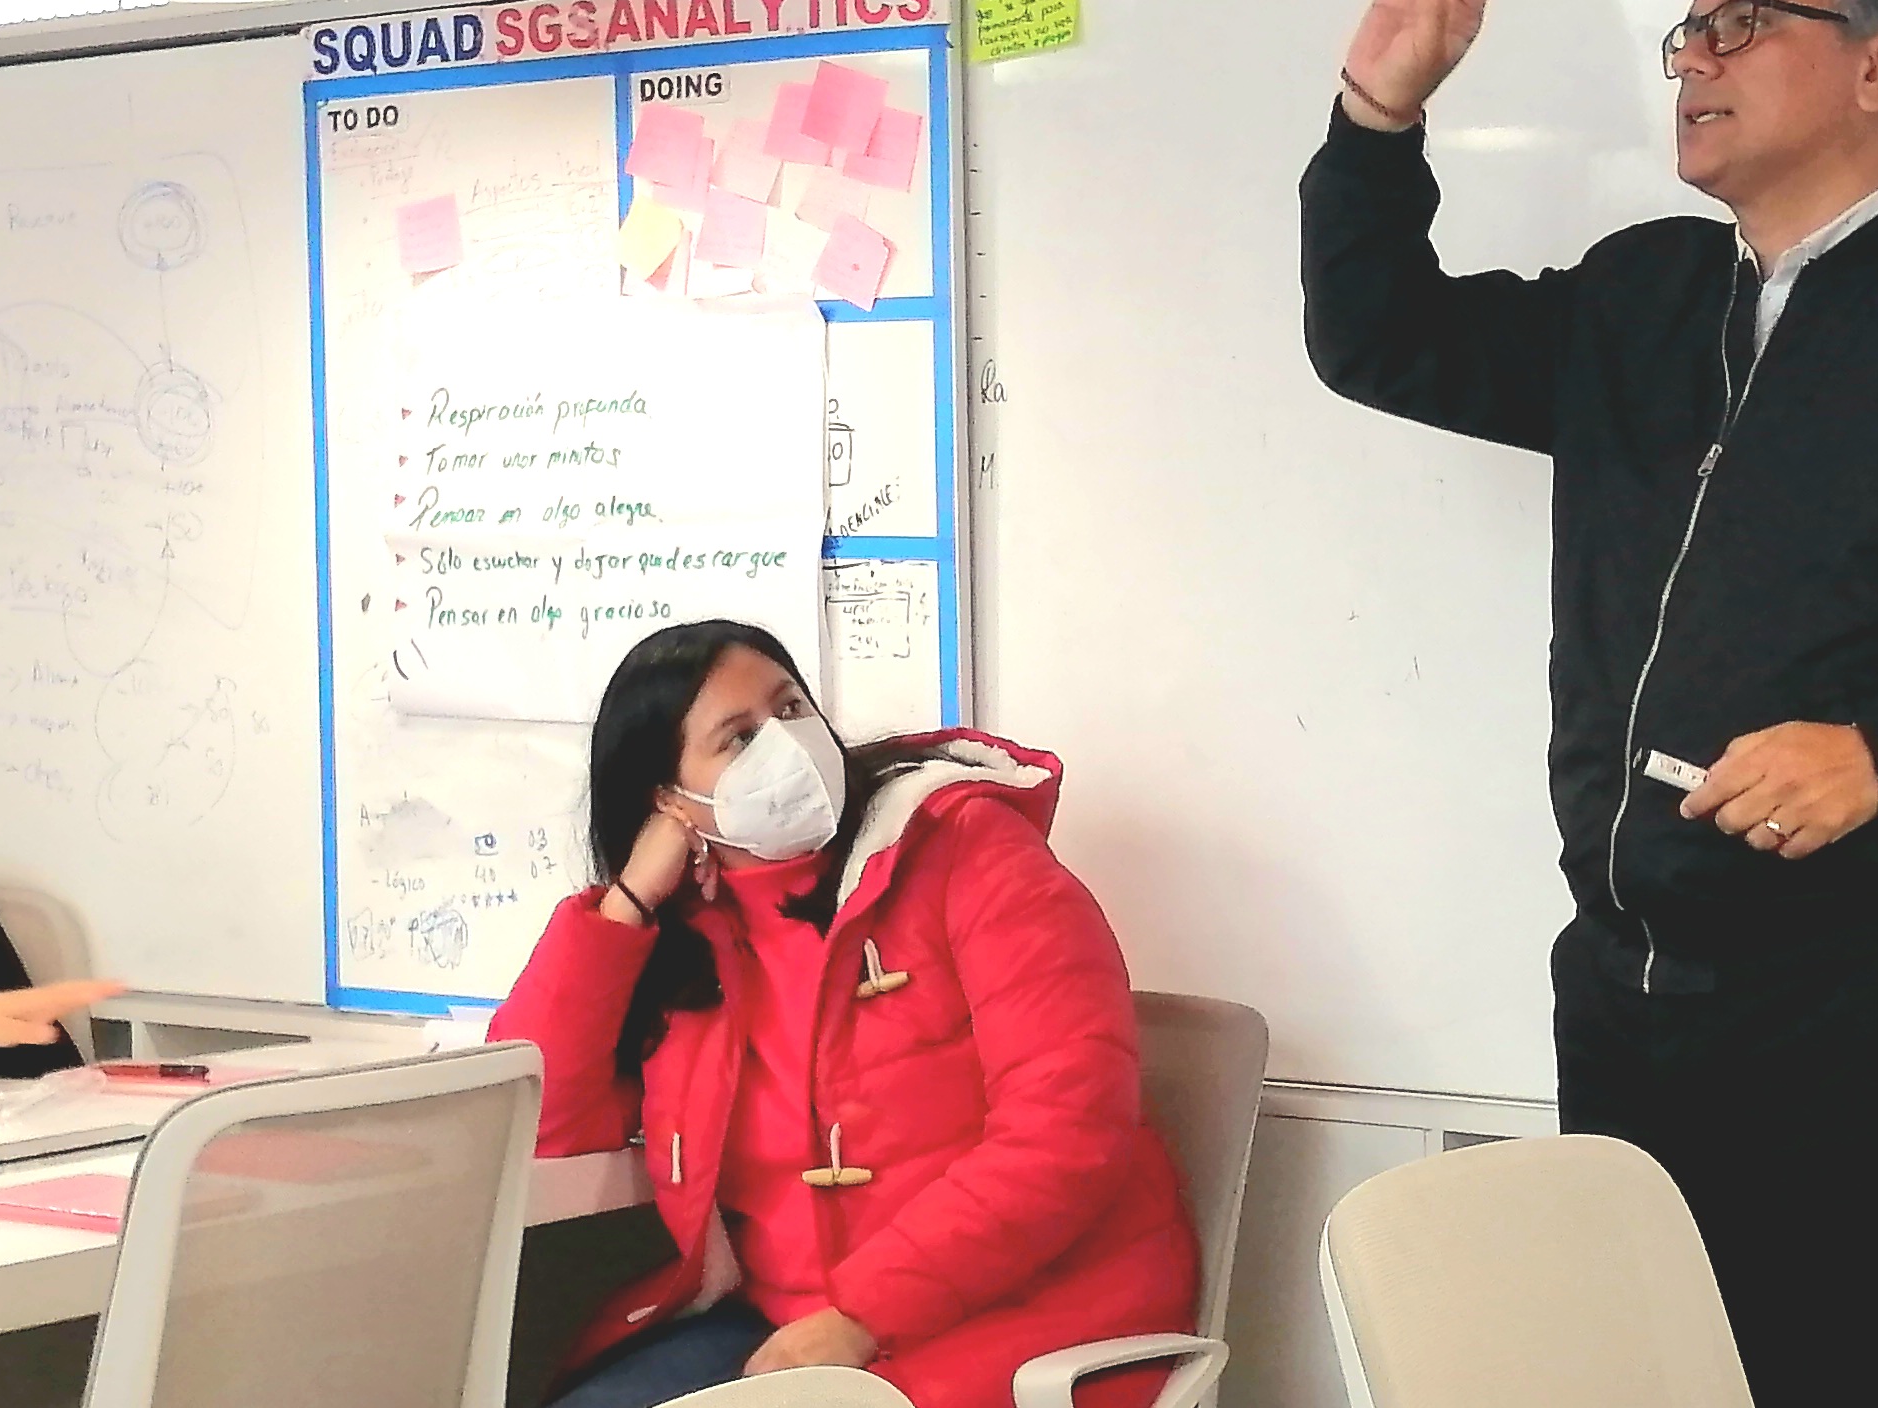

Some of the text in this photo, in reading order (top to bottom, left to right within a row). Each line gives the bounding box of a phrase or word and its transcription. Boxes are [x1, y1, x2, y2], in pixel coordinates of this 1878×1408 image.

[312, 13, 484, 74] SQUAD
[639, 72, 723, 102] DOING
[327, 104, 399, 133] TO DO
